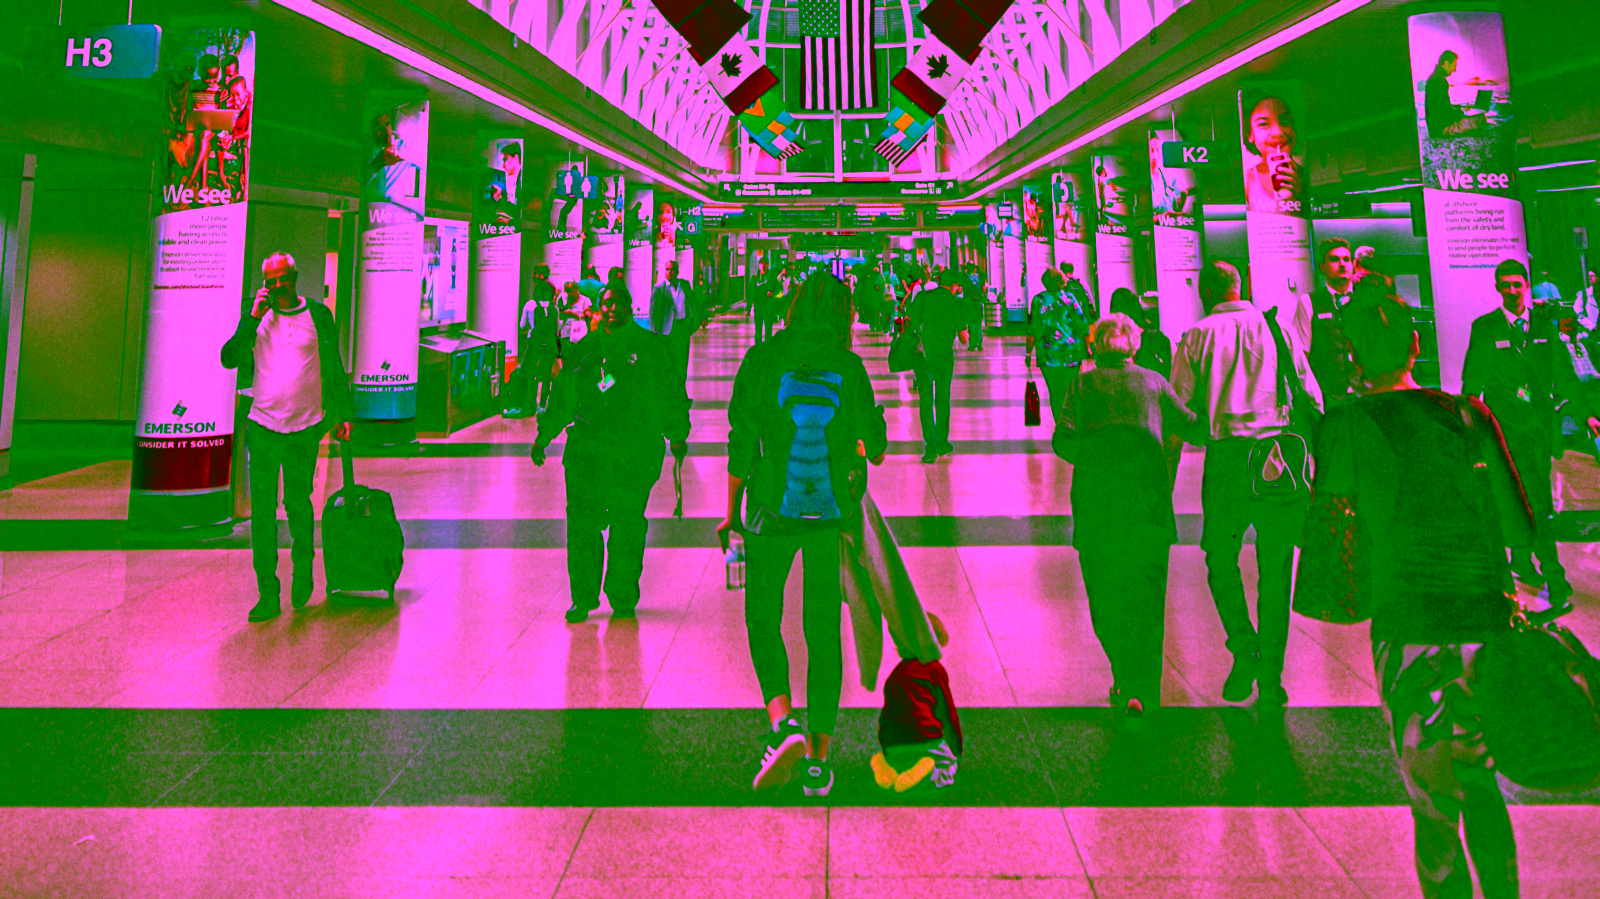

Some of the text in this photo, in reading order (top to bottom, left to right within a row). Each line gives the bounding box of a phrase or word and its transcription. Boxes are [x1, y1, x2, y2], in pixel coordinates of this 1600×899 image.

[66, 38, 112, 67] H3
[1182, 146, 1209, 163] K2
[1436, 169, 1509, 190] We see
[163, 184, 231, 204] We see
[675, 206, 701, 216] 1-H2
[1278, 200, 1301, 212] see
[369, 208, 416, 224] We see
[1158, 214, 1194, 227] We see
[1473, 216, 1492, 224] safety
[479, 223, 515, 234] We see
[687, 223, 696, 233] G
[1097, 224, 1127, 234] We see
[1480, 224, 1490, 232] dry
[549, 229, 579, 239] We see
[361, 374, 409, 382] EMERSON
[144, 421, 216, 434] EMERSON
[136, 438, 225, 449] CONSIDER IT SOLVED
